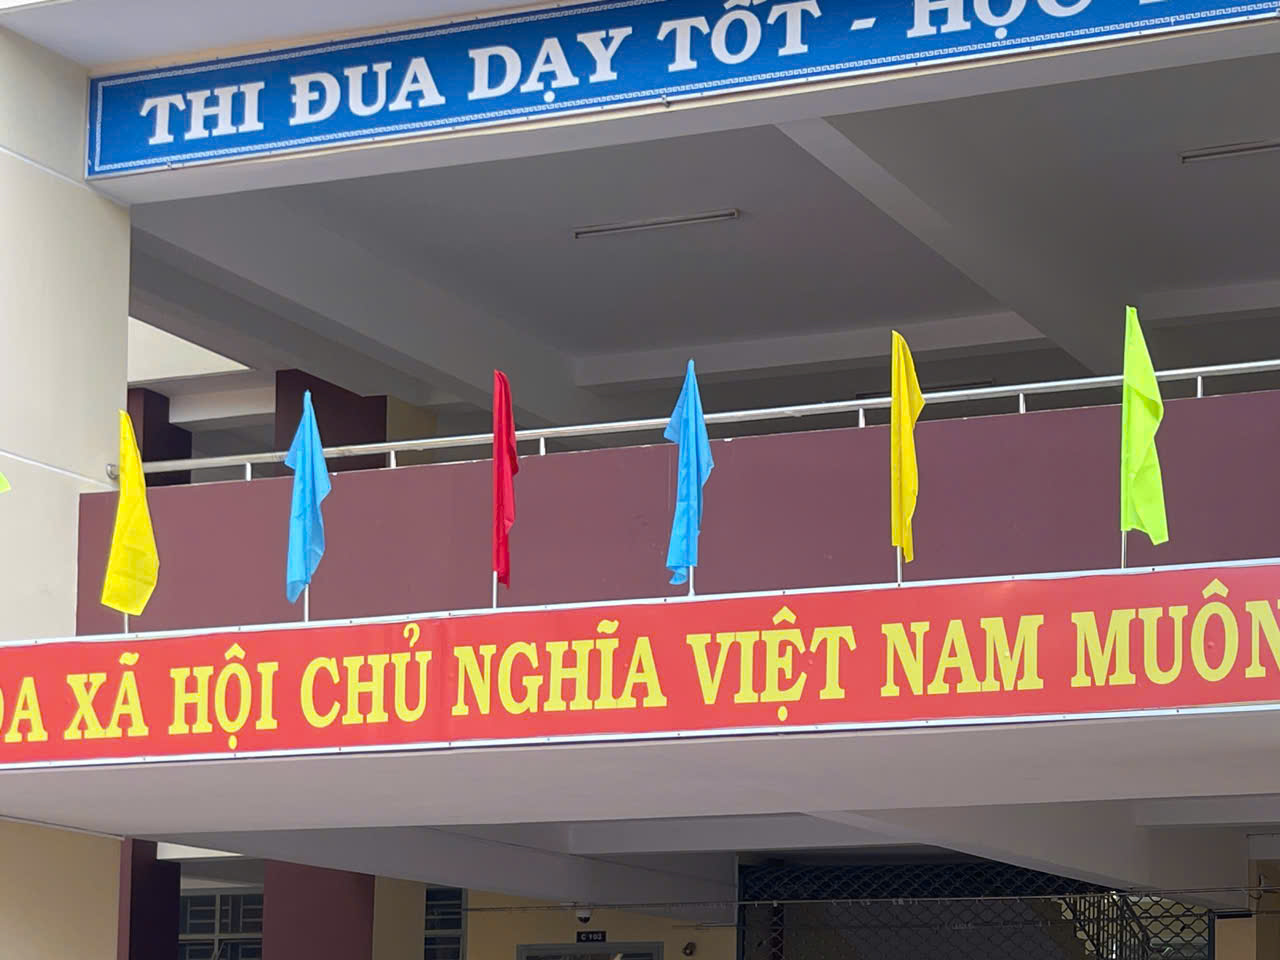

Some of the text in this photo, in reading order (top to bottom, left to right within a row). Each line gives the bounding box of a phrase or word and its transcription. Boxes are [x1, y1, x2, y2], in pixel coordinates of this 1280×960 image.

[139, 81, 265, 146] THI
[290, 57, 446, 127] ĐUA
[467, 27, 633, 103] DẠY
[657, 0, 822, 73] TỐT
[0, 676, 49, 743] A
[64, 652, 149, 741] XÃ
[168, 643, 279, 750] HỘI
[301, 623, 433, 729] CHỦ
[452, 620, 667, 717] NGHĨA
[686, 606, 857, 721] VIỆT
[881, 614, 1044, 697] NAM
